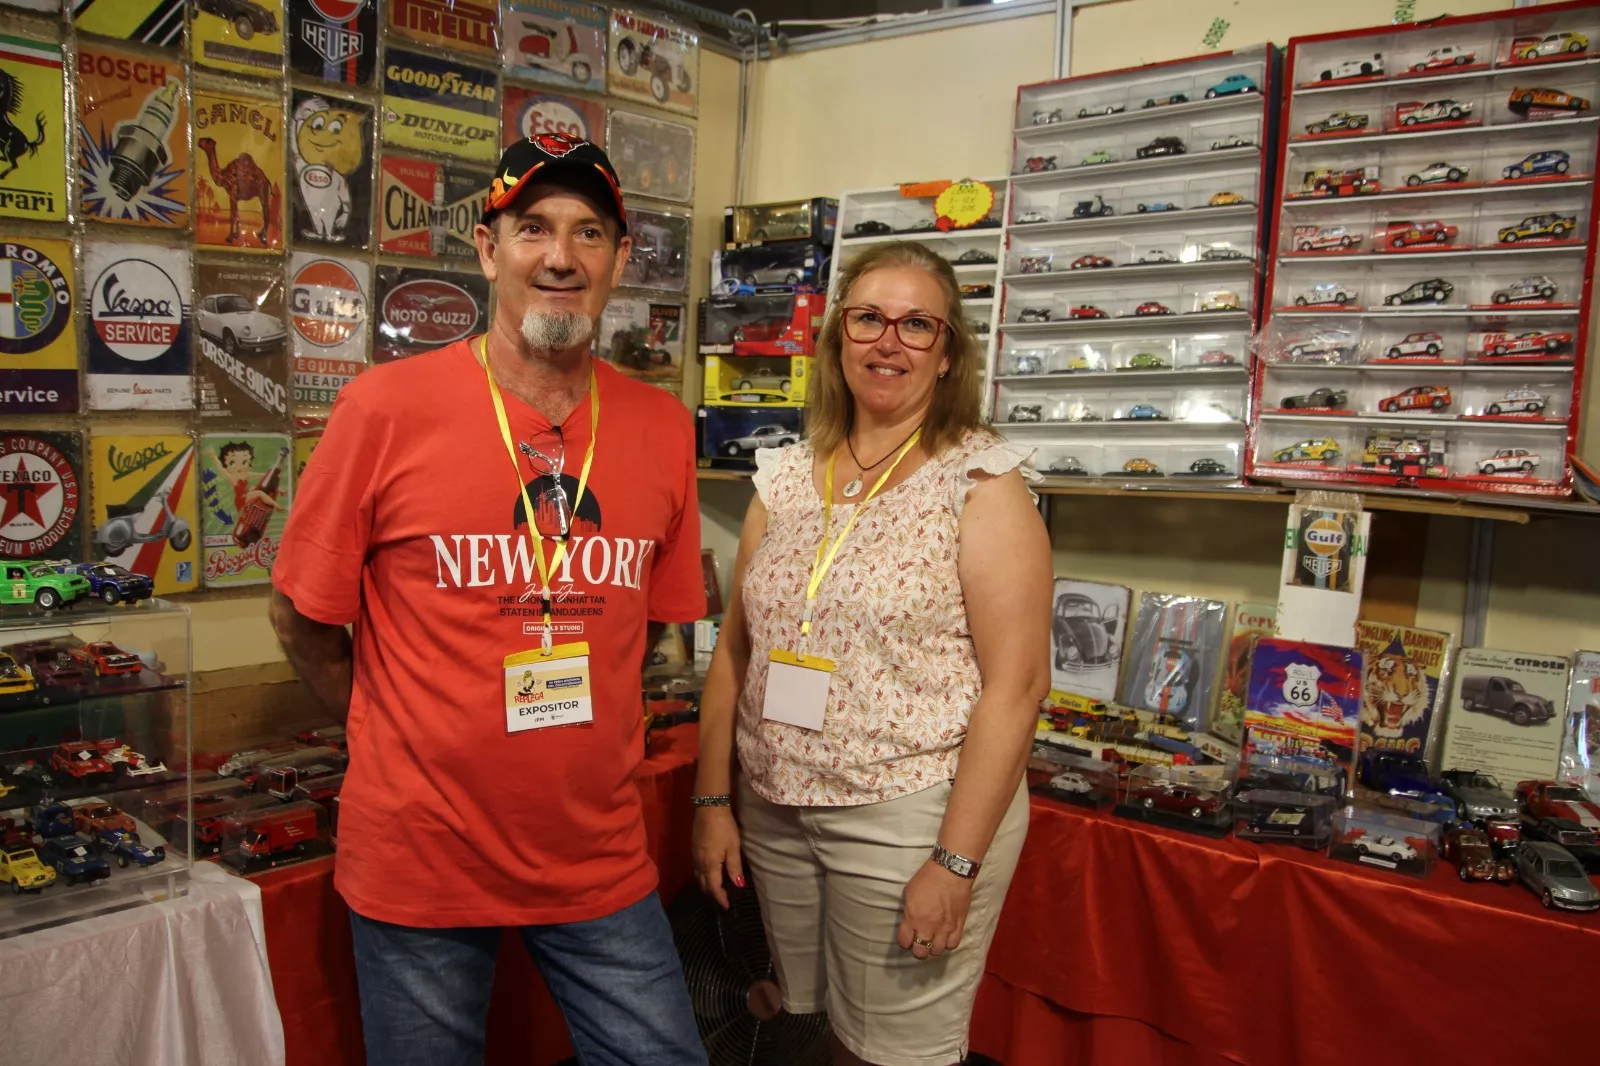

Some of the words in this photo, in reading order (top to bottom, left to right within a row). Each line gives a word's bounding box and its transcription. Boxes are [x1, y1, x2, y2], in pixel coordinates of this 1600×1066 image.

[393, 0, 497, 48] PIRELLI
[305, 24, 359, 60] HEUER
[79, 53, 167, 86] BOSCH
[195, 103, 277, 142] CAMEL
[401, 113, 495, 140] DUNLOP
[385, 185, 487, 239] CHAMPION
[5, 244, 70, 305] ROMEO
[102, 273, 172, 318] Vespa
[432, 311, 471, 325] GUZZI
[105, 324, 171, 343] SERVICE
[296, 359, 357, 373] EGULAR
[294, 376, 352, 387] NLEADE
[295, 389, 337, 401] DIESE
[11, 439, 66, 468] COMPANY
[108, 441, 170, 477] Vespa
[30, 507, 75, 554] PRODUCTS
[1307, 530, 1343, 544] Gulf
[429, 535, 543, 587] NEW
[554, 535, 655, 590] YORK
[1305, 559, 1339, 575] HEUER
[497, 596, 515, 604] THE
[517, 596, 546, 604] BRON
[500, 608, 535, 616] STATEN
[1404, 630, 1444, 651] BARNUM
[514, 692, 544, 704] REPLEGA
[1291, 686, 1311, 701] 66
[518, 701, 579, 717] EXPOSITOR
